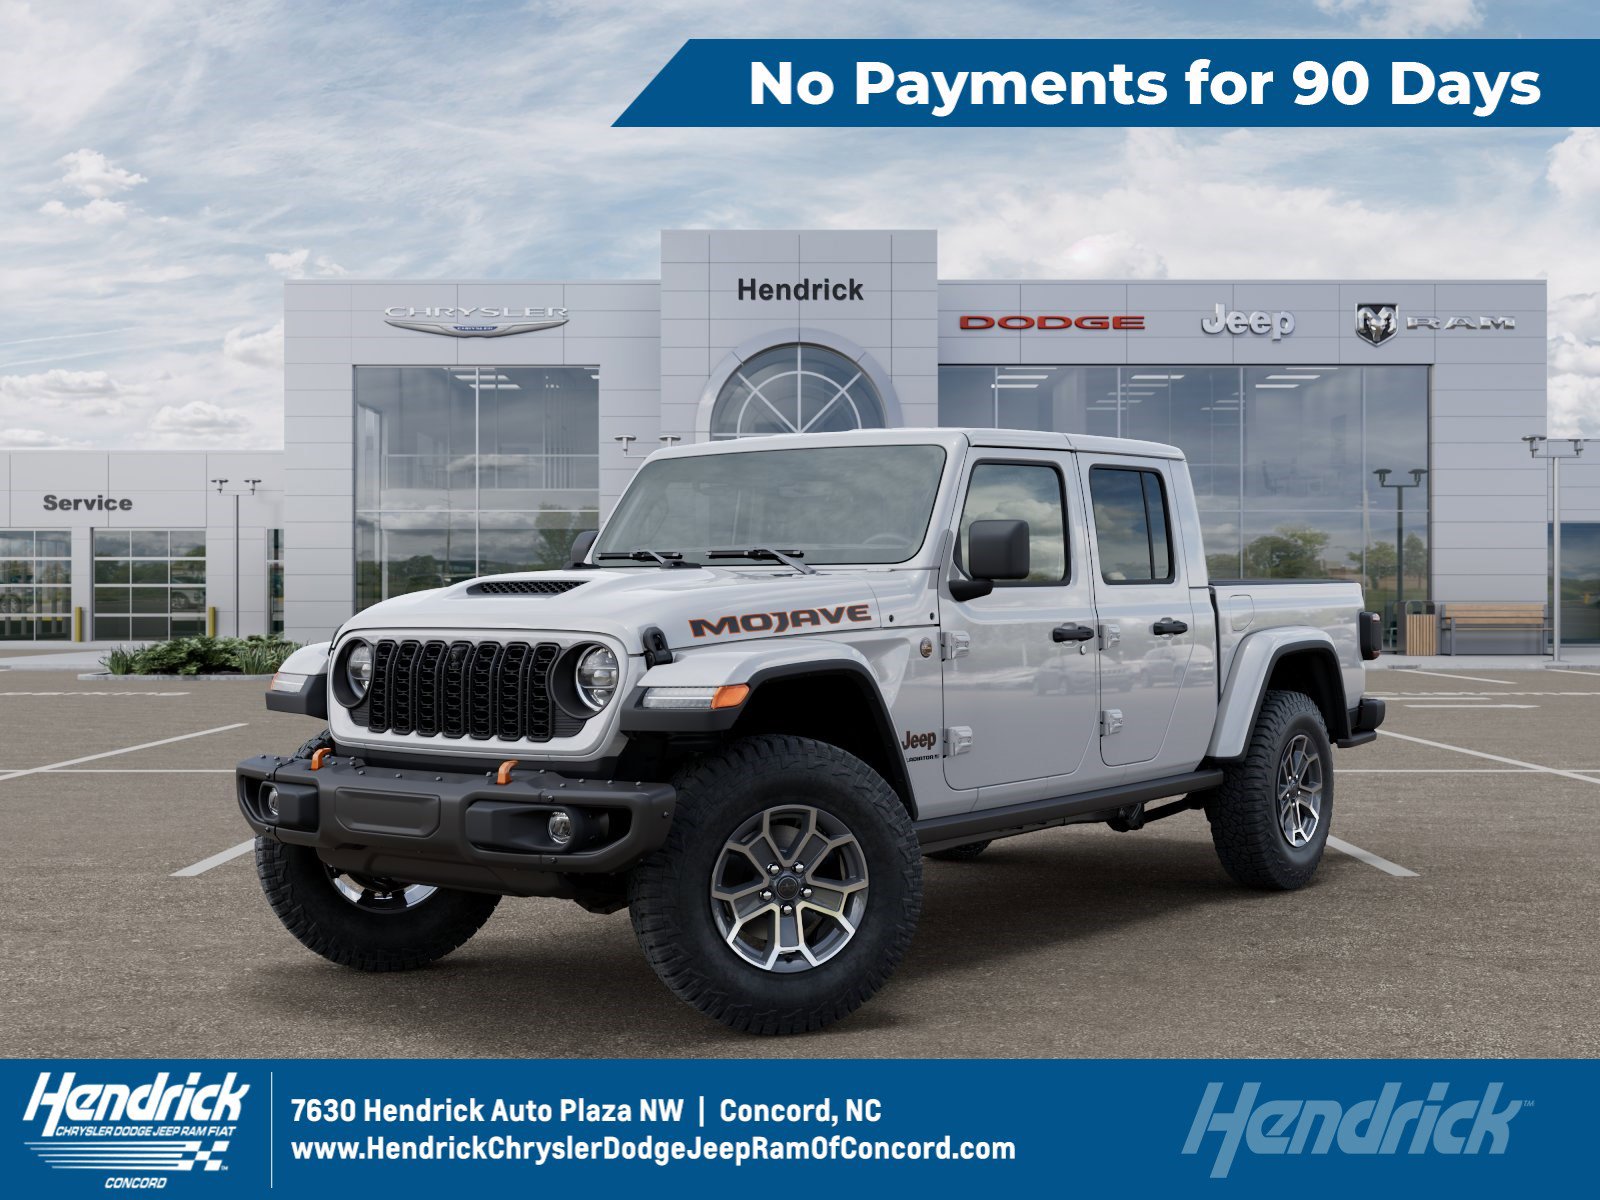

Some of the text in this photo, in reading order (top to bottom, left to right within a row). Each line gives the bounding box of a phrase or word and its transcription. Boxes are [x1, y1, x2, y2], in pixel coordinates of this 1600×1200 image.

[737, 278, 864, 301] Hendrick
[385, 306, 570, 317] CHRYSLER
[960, 315, 1146, 330] DODGE
[1201, 303, 1295, 341] Jeep
[1406, 316, 1516, 330] RAM
[43, 494, 133, 511] Service
[688, 604, 872, 638] MOJAVE
[901, 730, 937, 750] Jeep
